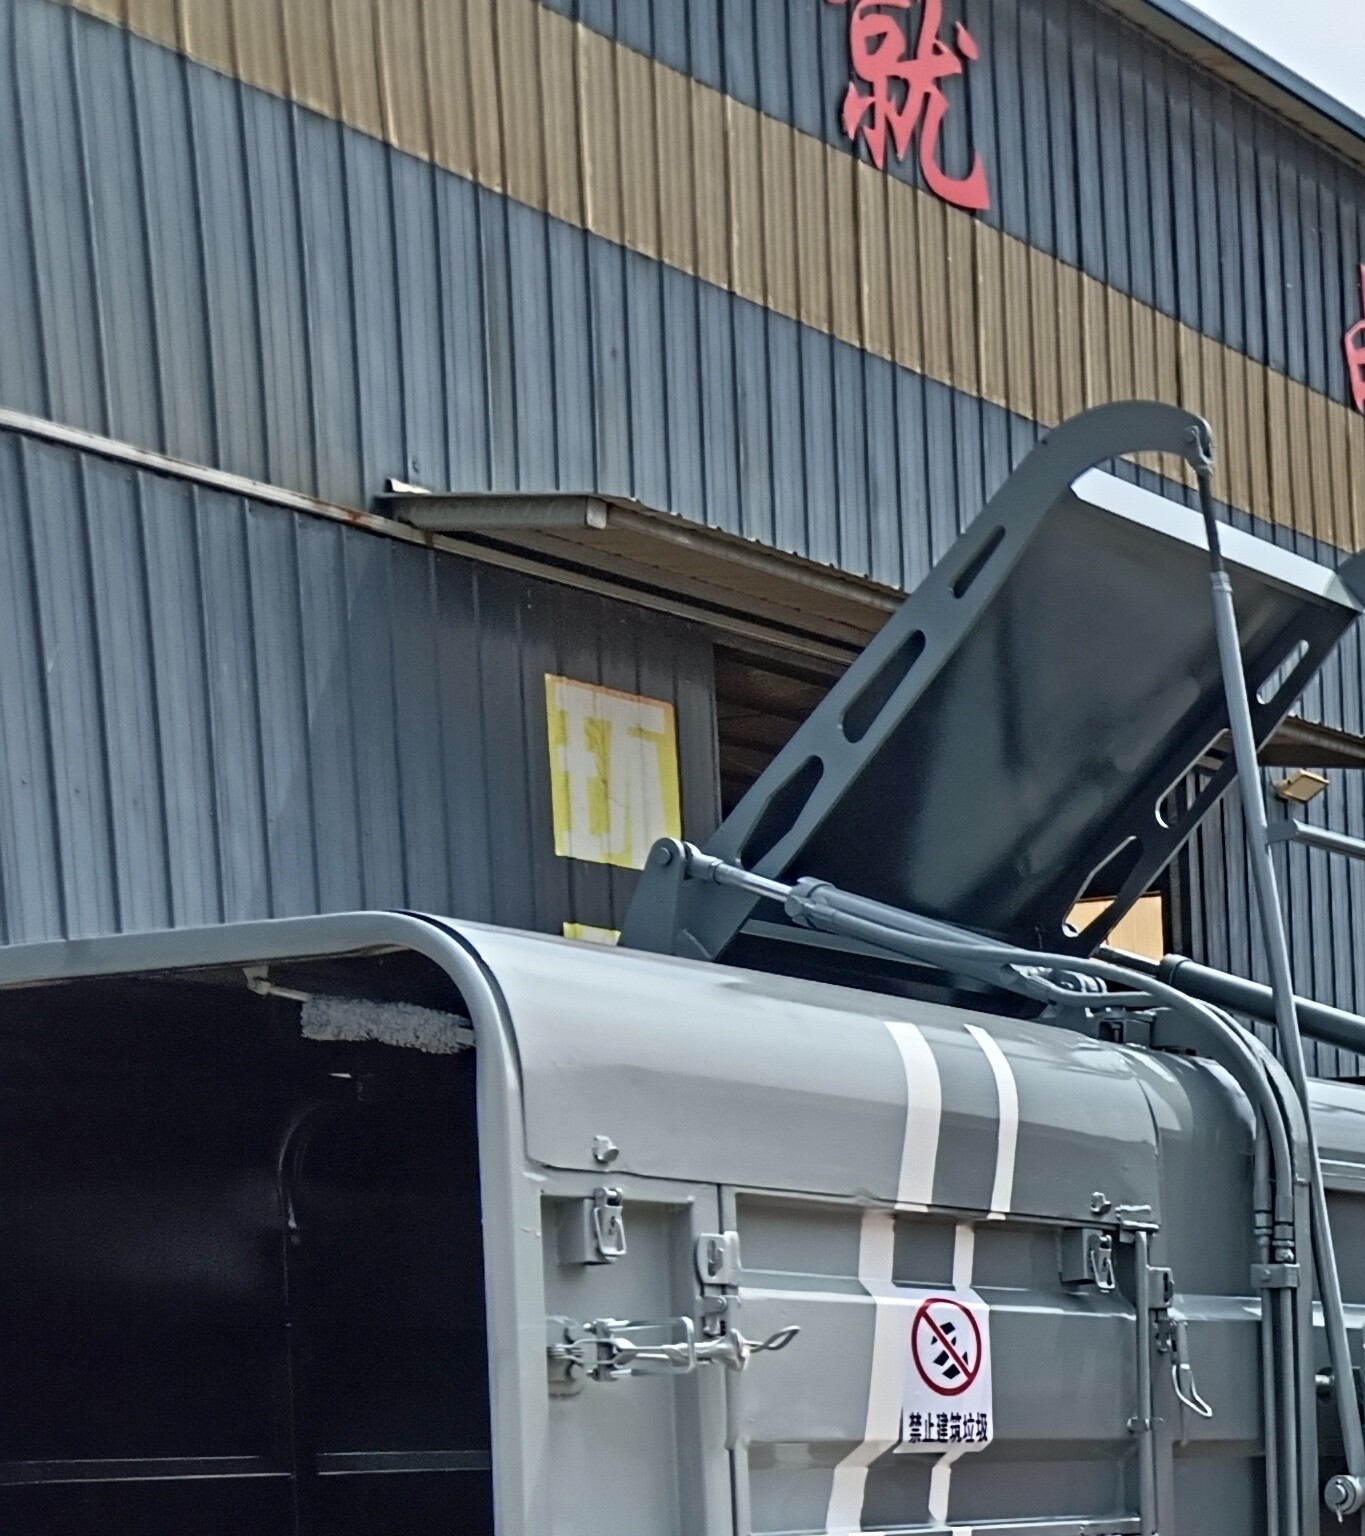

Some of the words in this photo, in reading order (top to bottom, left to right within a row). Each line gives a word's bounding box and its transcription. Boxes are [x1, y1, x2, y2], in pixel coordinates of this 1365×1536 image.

[908, 1411, 989, 1444] 禁止建筑垃圾
